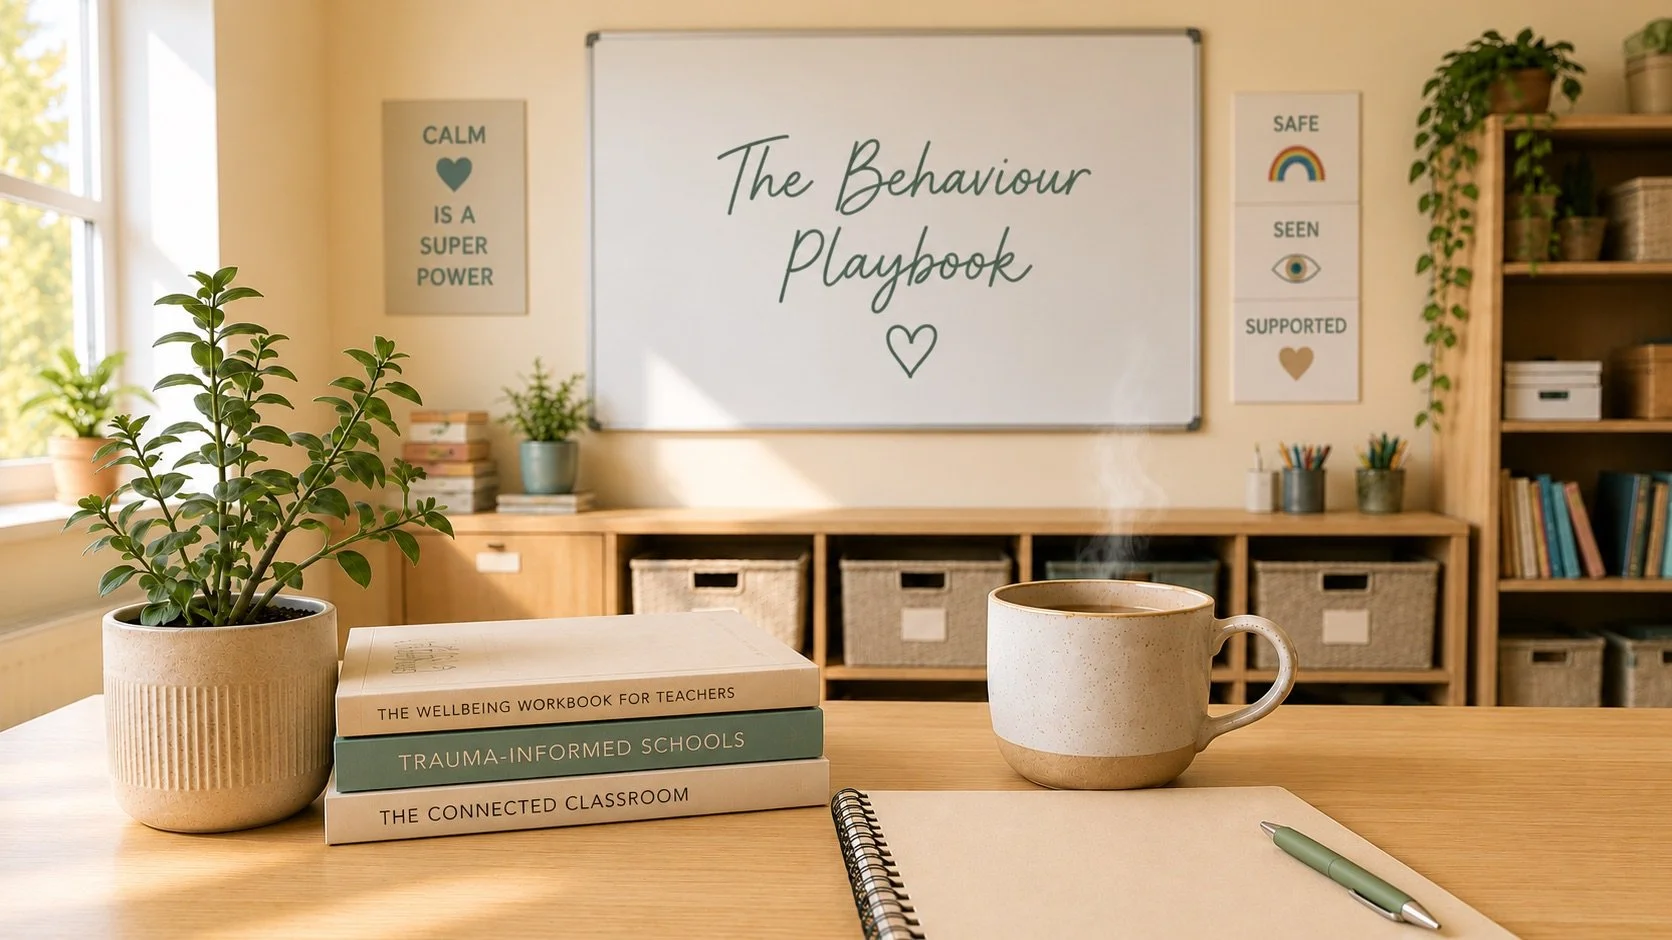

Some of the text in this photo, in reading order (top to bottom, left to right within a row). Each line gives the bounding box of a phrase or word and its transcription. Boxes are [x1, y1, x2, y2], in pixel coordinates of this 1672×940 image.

[1273, 115, 1320, 132] SAFE
[422, 125, 486, 145] CALM
[717, 134, 1092, 215] The Behaviour
[434, 205, 476, 224] IS A
[1273, 221, 1320, 238] SEEN
[420, 236, 488, 255] SUPER
[417, 267, 494, 286] POWER
[778, 225, 1033, 314] Playbook
[1245, 317, 1347, 335] SUPPORTED
[377, 686, 735, 721] THE WELLBEING WORKBOOK FOR TEACHERS
[398, 731, 746, 772] TRAUMA-INFORMED SCHOOLS
[379, 787, 690, 826] THE CONNECTED CLASSROOM
